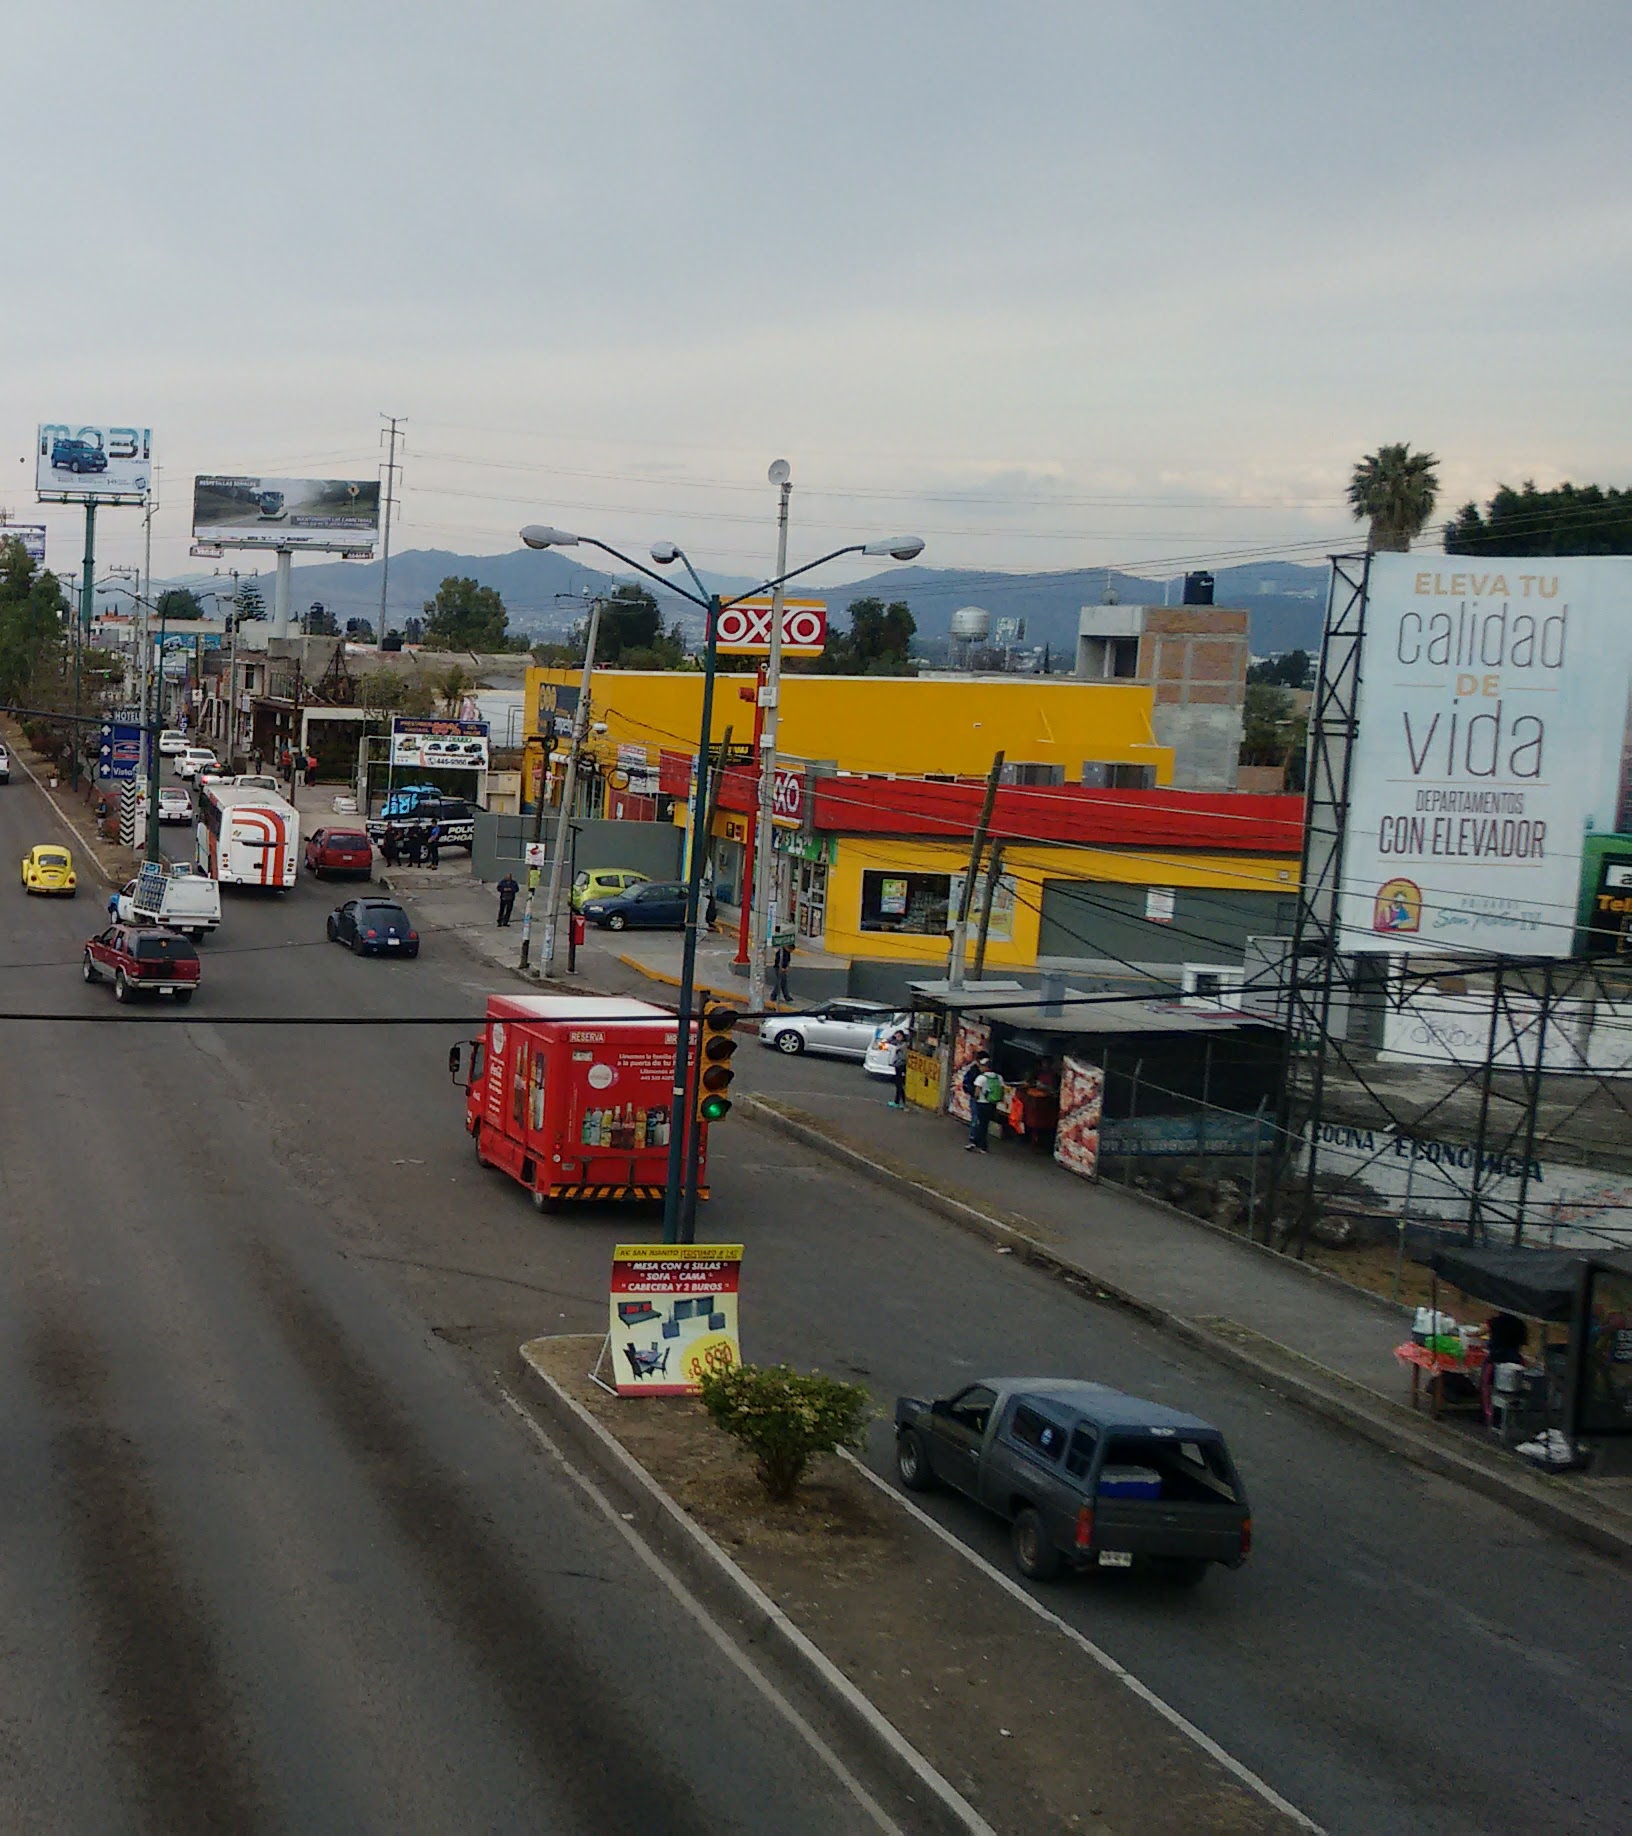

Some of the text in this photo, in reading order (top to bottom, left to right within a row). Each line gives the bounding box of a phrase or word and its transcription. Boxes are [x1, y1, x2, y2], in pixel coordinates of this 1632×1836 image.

[1414, 573, 1559, 598] ELEVA TU
[717, 609, 821, 644] OXXO
[1397, 601, 1568, 669] calidad
[1455, 673, 1501, 697] DE
[114, 711, 140, 721] HOTEL
[1403, 698, 1545, 779] vida
[113, 767, 133, 776] Vista
[1415, 789, 1524, 815] DEPARTAMENTOS
[1379, 815, 1547, 859] CON ELEVADOR
[570, 1032, 605, 1043] RESERVA
[632, 1262, 659, 1271] MESA
[660, 1262, 682, 1271] CON
[691, 1262, 721, 1271] SILLAS
[646, 1272, 671, 1281] SOFA
[679, 1272, 707, 1281] CAMA
[628, 1282, 674, 1291] CABECERA
[674, 1282, 682, 1291] Y
[691, 1283, 723, 1291] BUROS
